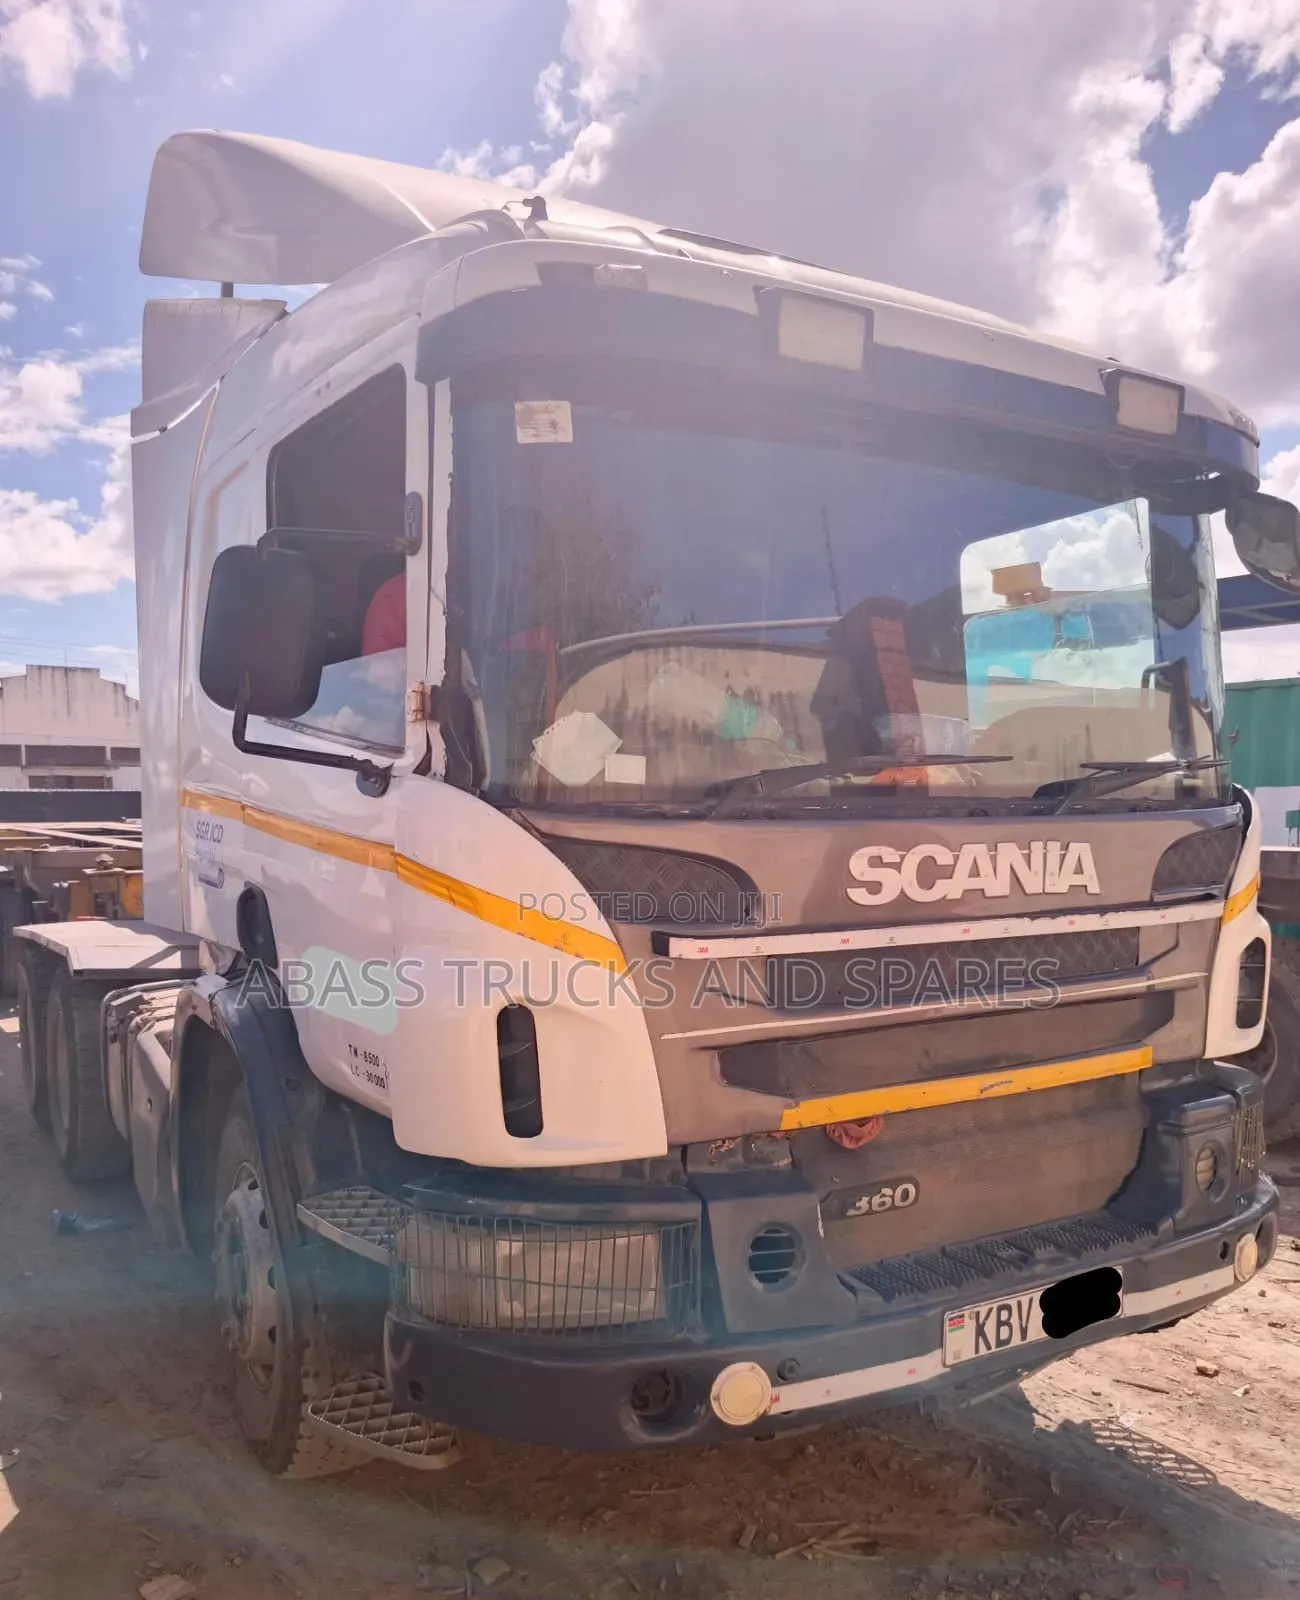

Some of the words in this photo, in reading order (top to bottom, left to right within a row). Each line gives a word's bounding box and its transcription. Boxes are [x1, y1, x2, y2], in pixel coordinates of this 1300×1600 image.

[846, 840, 1101, 906] SCANIA
[846, 1183, 916, 1216] 360
[974, 1296, 1034, 1355] KBV
